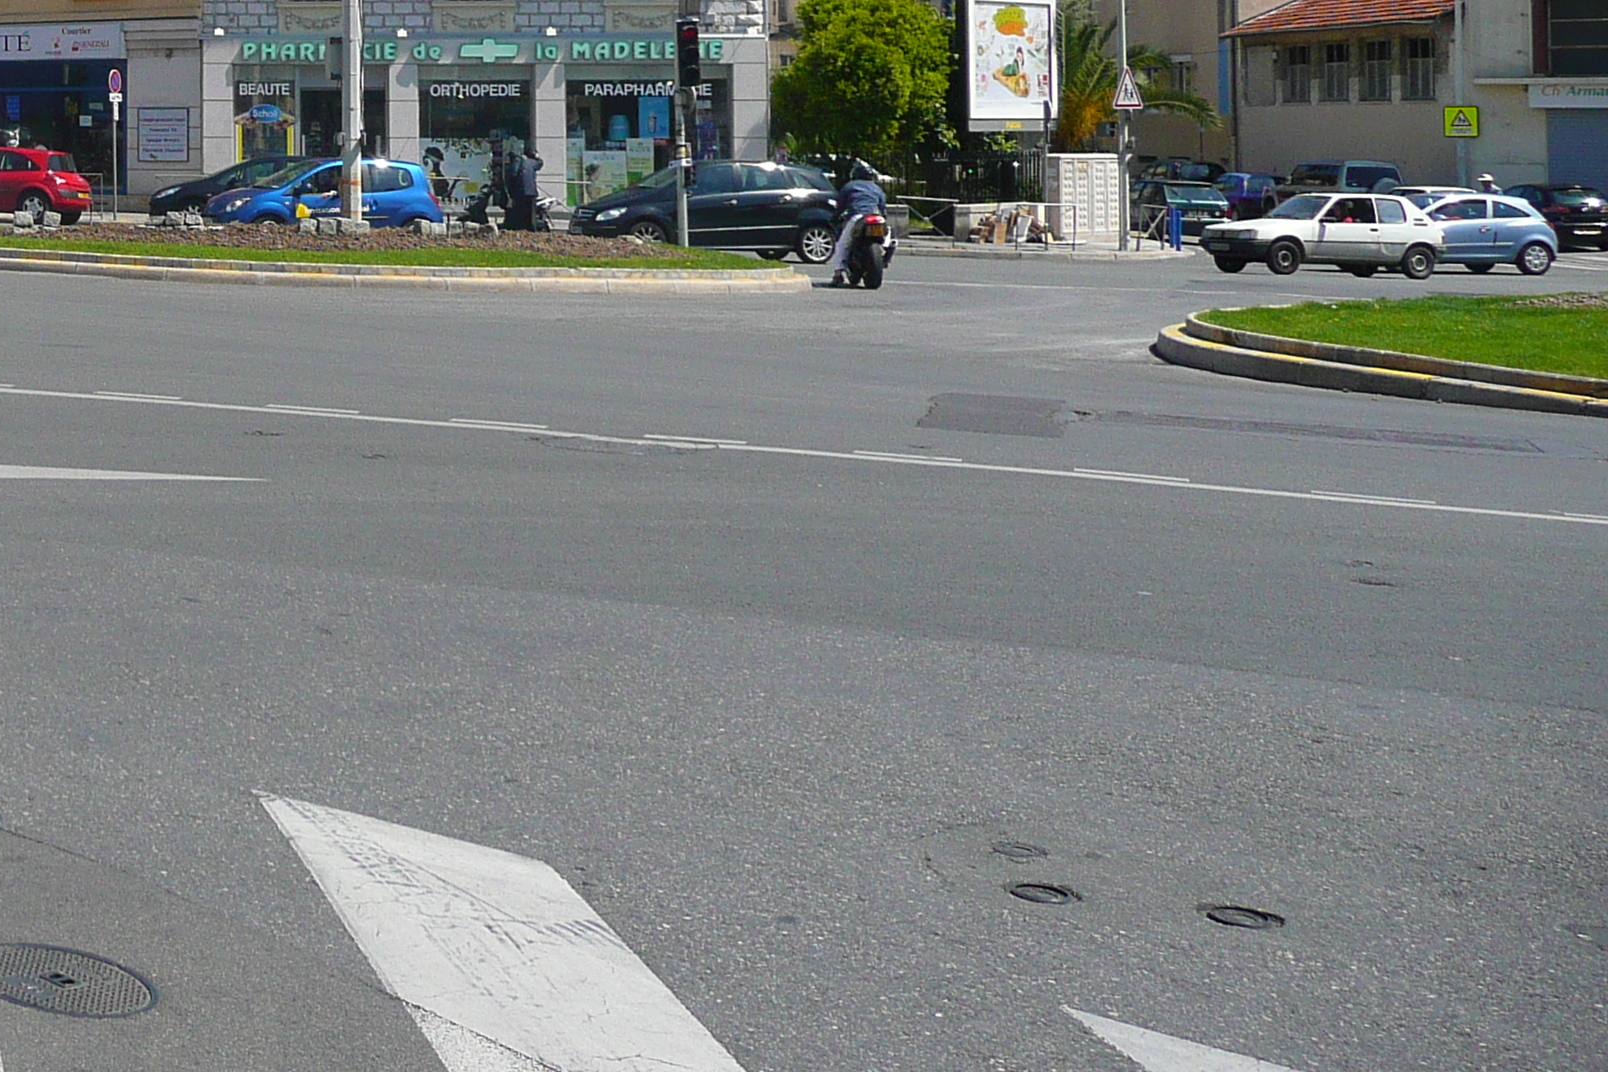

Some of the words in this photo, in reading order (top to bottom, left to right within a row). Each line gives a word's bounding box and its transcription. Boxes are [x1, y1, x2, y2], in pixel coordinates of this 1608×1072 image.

[413, 42, 442, 61] de
[535, 42, 559, 60] la
[239, 83, 290, 96] BEAUTE
[430, 83, 521, 97] ORTHOPEDIE
[584, 83, 712, 96] PARAPHARMIE
